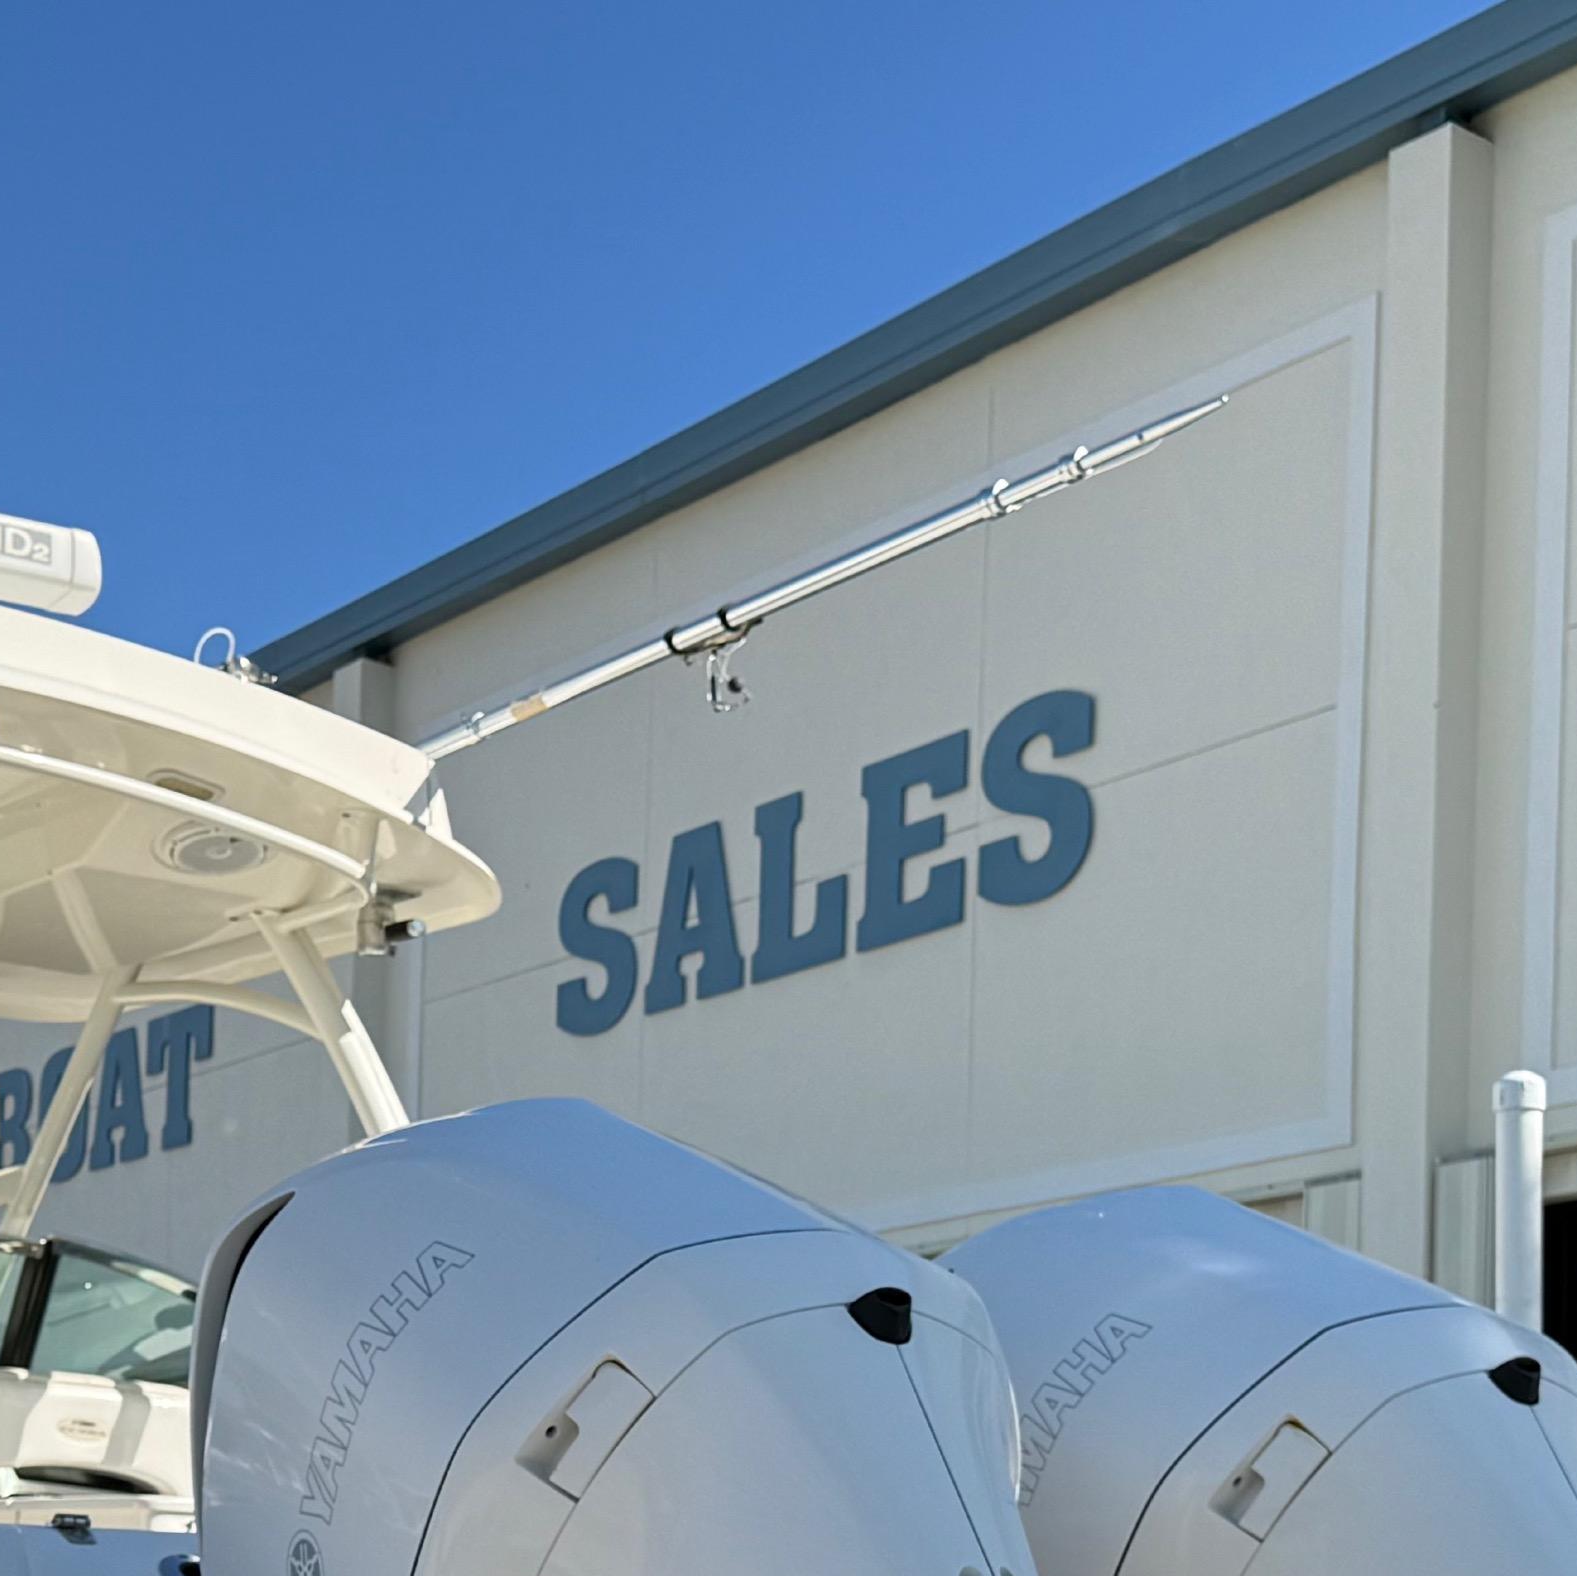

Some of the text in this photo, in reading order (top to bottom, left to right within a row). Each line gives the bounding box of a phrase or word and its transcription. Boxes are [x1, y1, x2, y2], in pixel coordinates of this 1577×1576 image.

[556, 688, 1097, 1037] SALES
[298, 1240, 476, 1525] YAMAHA
[1019, 1312, 1154, 1507] MAHA
